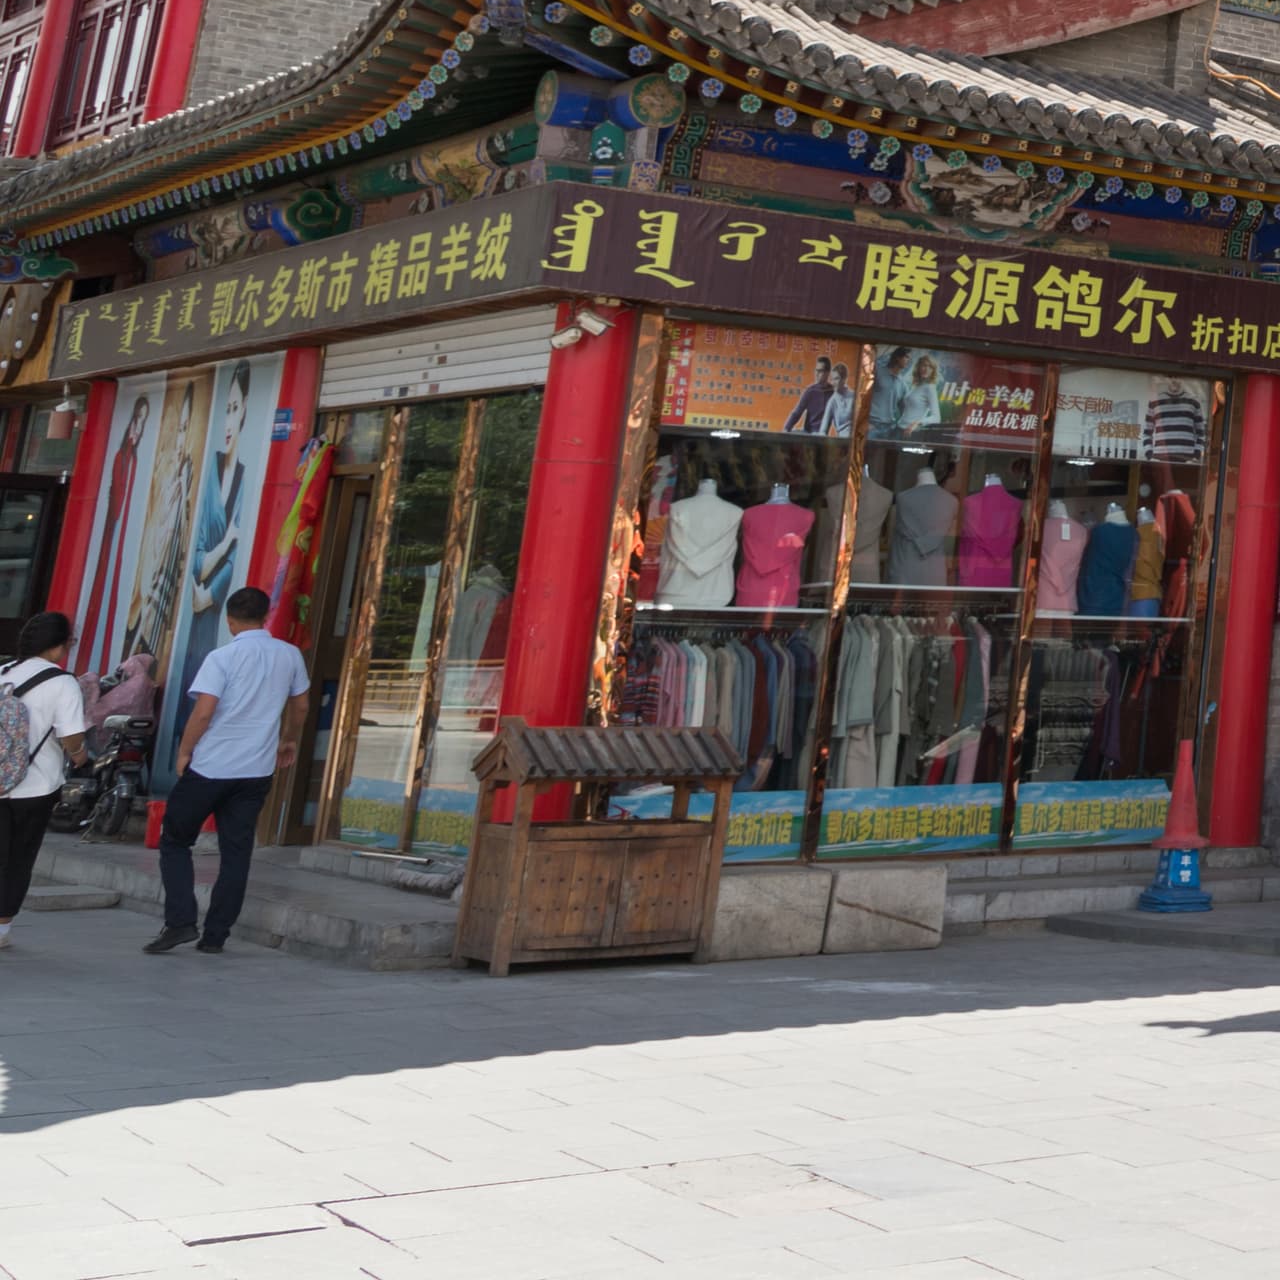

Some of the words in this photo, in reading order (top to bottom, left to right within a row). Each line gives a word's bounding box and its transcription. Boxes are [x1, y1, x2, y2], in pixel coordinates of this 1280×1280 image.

[210, 251, 358, 336] 鄂尔多斯市
[364, 212, 512, 306] 精品羊绒
[856, 242, 1177, 344] 腾源鸽尔
[940, 381, 1034, 411] 时尚羊绒
[965, 409, 1039, 431] 品质优雅
